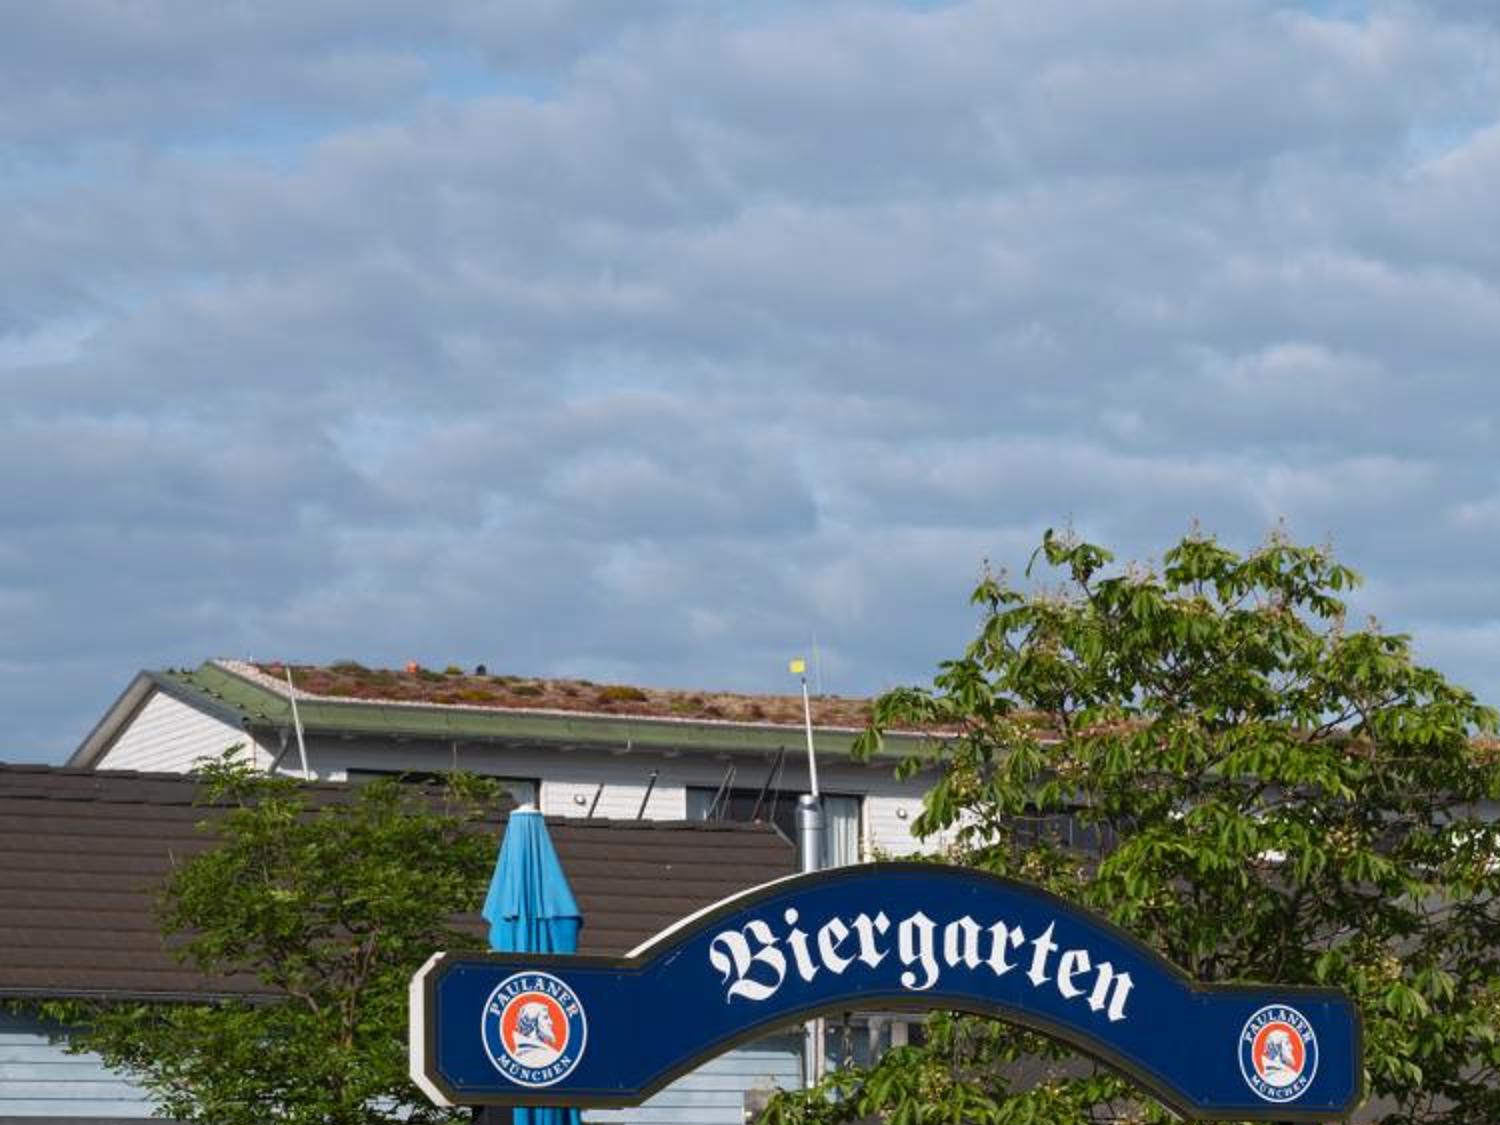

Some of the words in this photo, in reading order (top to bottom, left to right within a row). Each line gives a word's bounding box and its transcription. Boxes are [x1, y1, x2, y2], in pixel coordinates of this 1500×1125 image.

[708, 907, 1136, 1023] Biergarten
[488, 976, 579, 1018] PAULANER
[1243, 1010, 1313, 1043] PAULANER
[497, 1053, 573, 1082] MÜNCHEN
[1251, 1074, 1308, 1099] MÜNCHEN
